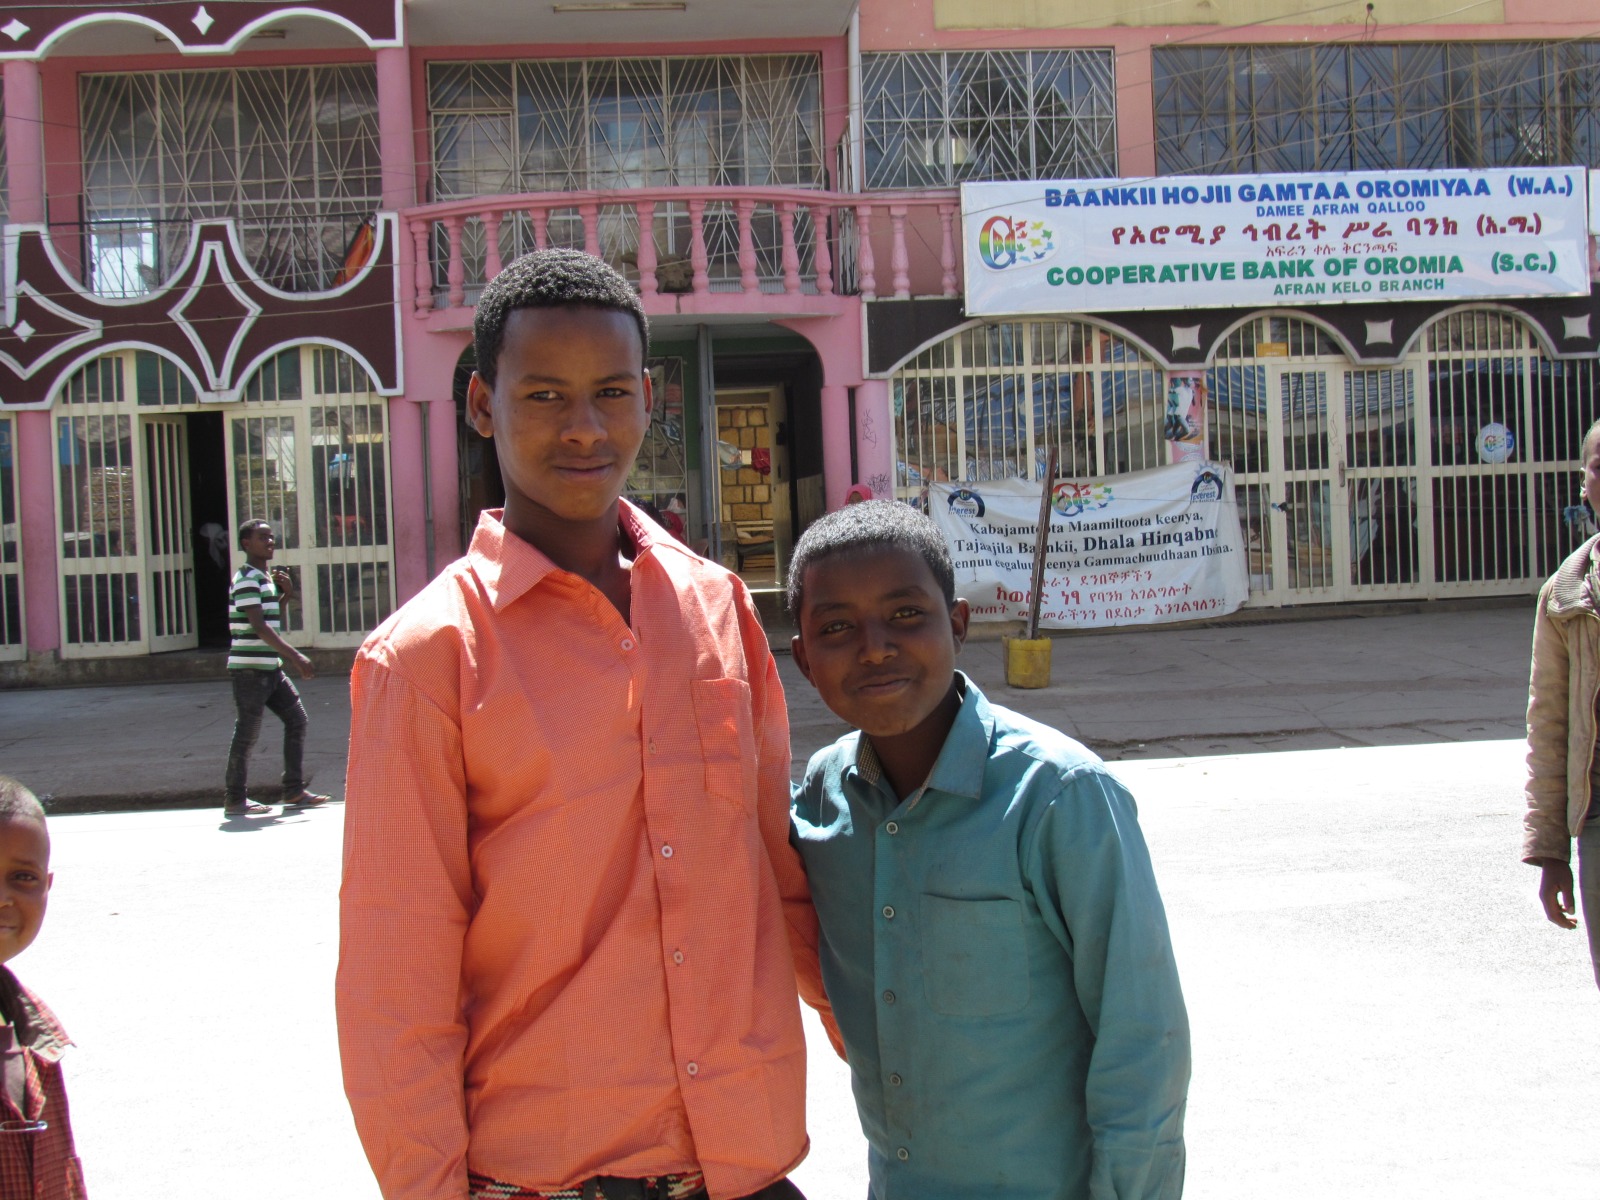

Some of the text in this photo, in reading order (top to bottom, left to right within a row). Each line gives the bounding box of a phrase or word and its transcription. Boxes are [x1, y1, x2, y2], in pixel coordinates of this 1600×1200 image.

[1045, 174, 1573, 207] BAANKII HOJII GAMTAA OROMIYAA (W.A.)
[1256, 200, 1426, 217] DAMEE AFRAN QALLOO
[1406, 216, 1459, 237] ባንክ
[1046, 251, 1557, 286] COOPERATIVE BANK OF OROMIA (S.C.)
[1273, 278, 1445, 296] AFRAN KELO BRANCH
[1068, 516, 1152, 533] Maamiltoota
[1155, 512, 1203, 525] keenya,
[1018, 540, 1078, 554] Bankii,
[1083, 534, 1135, 551] Dhala
[952, 558, 992, 569] ennuu
[1044, 559, 1081, 571] eenya
[1084, 549, 1198, 568] Gammachuudhaan
